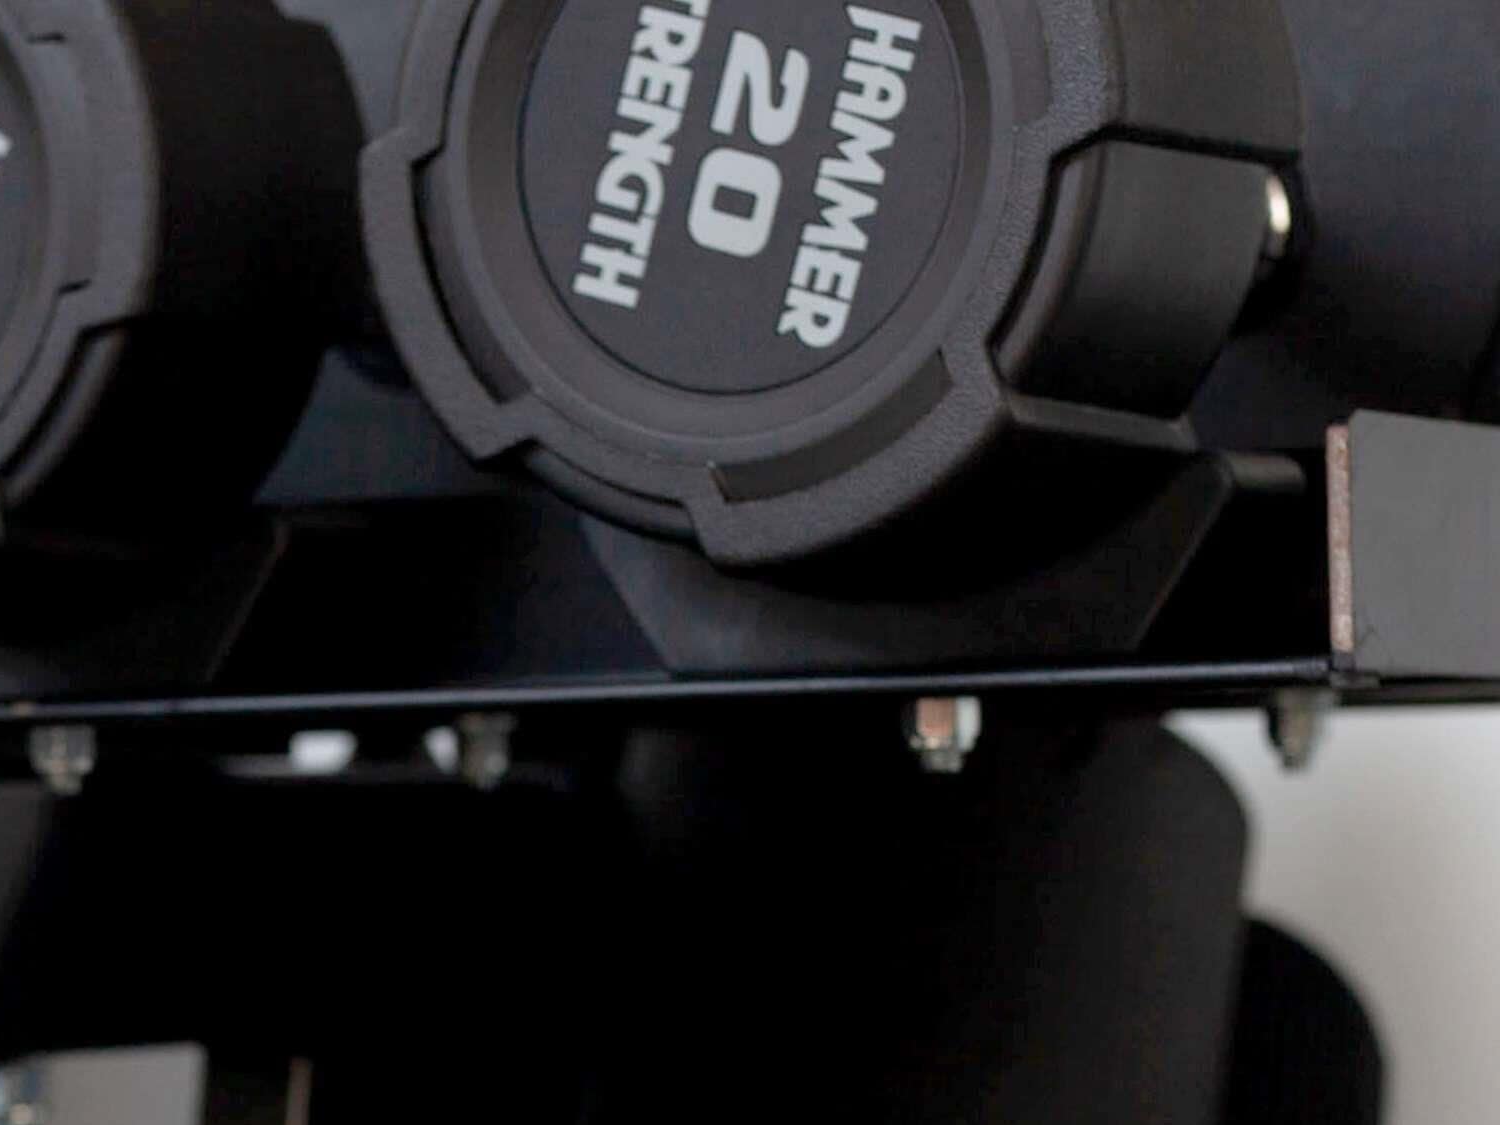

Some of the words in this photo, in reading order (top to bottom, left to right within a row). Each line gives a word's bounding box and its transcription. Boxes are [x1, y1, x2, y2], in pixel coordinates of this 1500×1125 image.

[573, 0, 711, 309] RENGTH
[688, 30, 810, 257] 20
[777, 4, 923, 348] HAMMER
